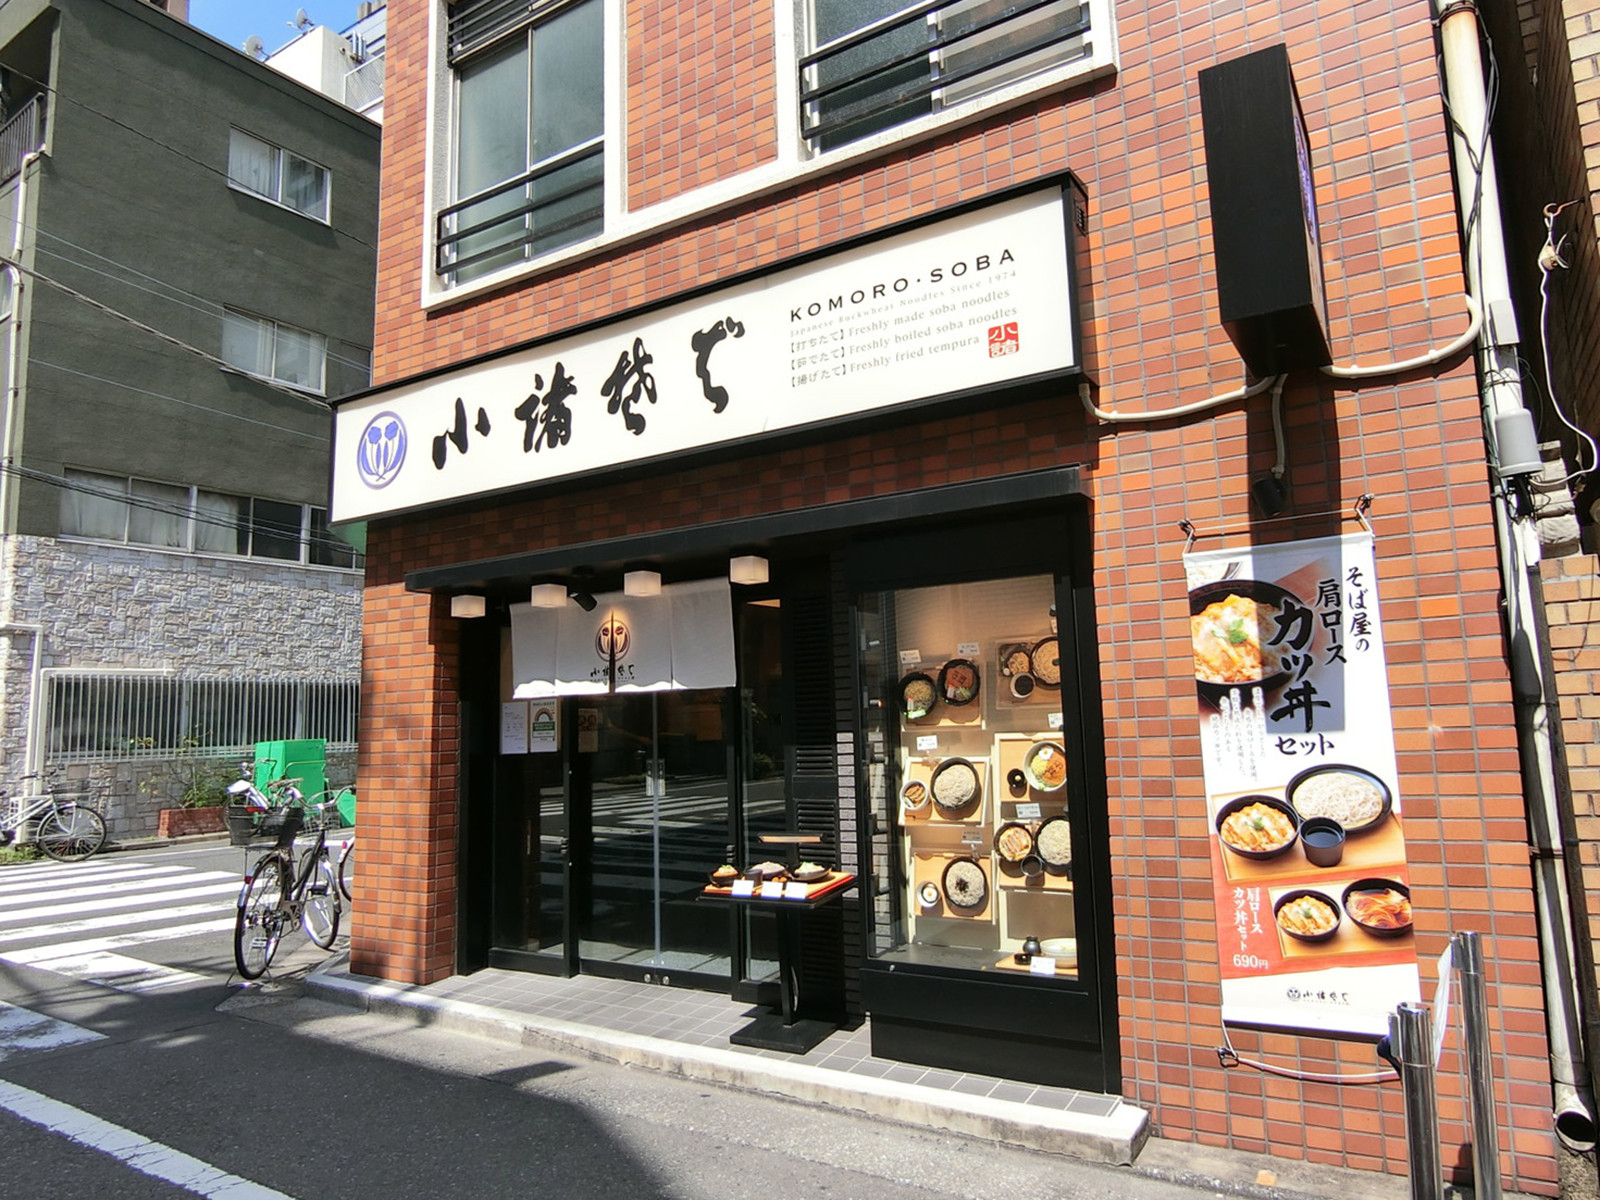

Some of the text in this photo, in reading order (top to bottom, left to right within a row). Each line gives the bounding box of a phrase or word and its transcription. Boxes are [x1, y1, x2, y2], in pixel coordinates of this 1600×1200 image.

[790, 270, 1017, 337] Japanese Buckwheat Noodles Since 1974
[848, 319, 890, 337] Freshly
[894, 310, 925, 325] made
[929, 302, 957, 317] soba
[961, 289, 1011, 309] noodles
[849, 337, 890, 355] Freshly
[894, 327, 931, 344] boiled
[936, 318, 964, 334] soba
[968, 306, 1018, 327] noodles
[849, 355, 891, 373] Freshly
[895, 346, 924, 363] fried
[928, 335, 980, 355] tempura
[1315, 578, 1347, 666] 肩ロース
[1345, 566, 1372, 652] そば屋の
[1267, 598, 1331, 733] カツ丼
[1275, 733, 1335, 756] セット
[1232, 886, 1248, 952] カツ丼セット
[1246, 887, 1263, 934] 肩ロース
[1233, 953, 1269, 970] 690円
